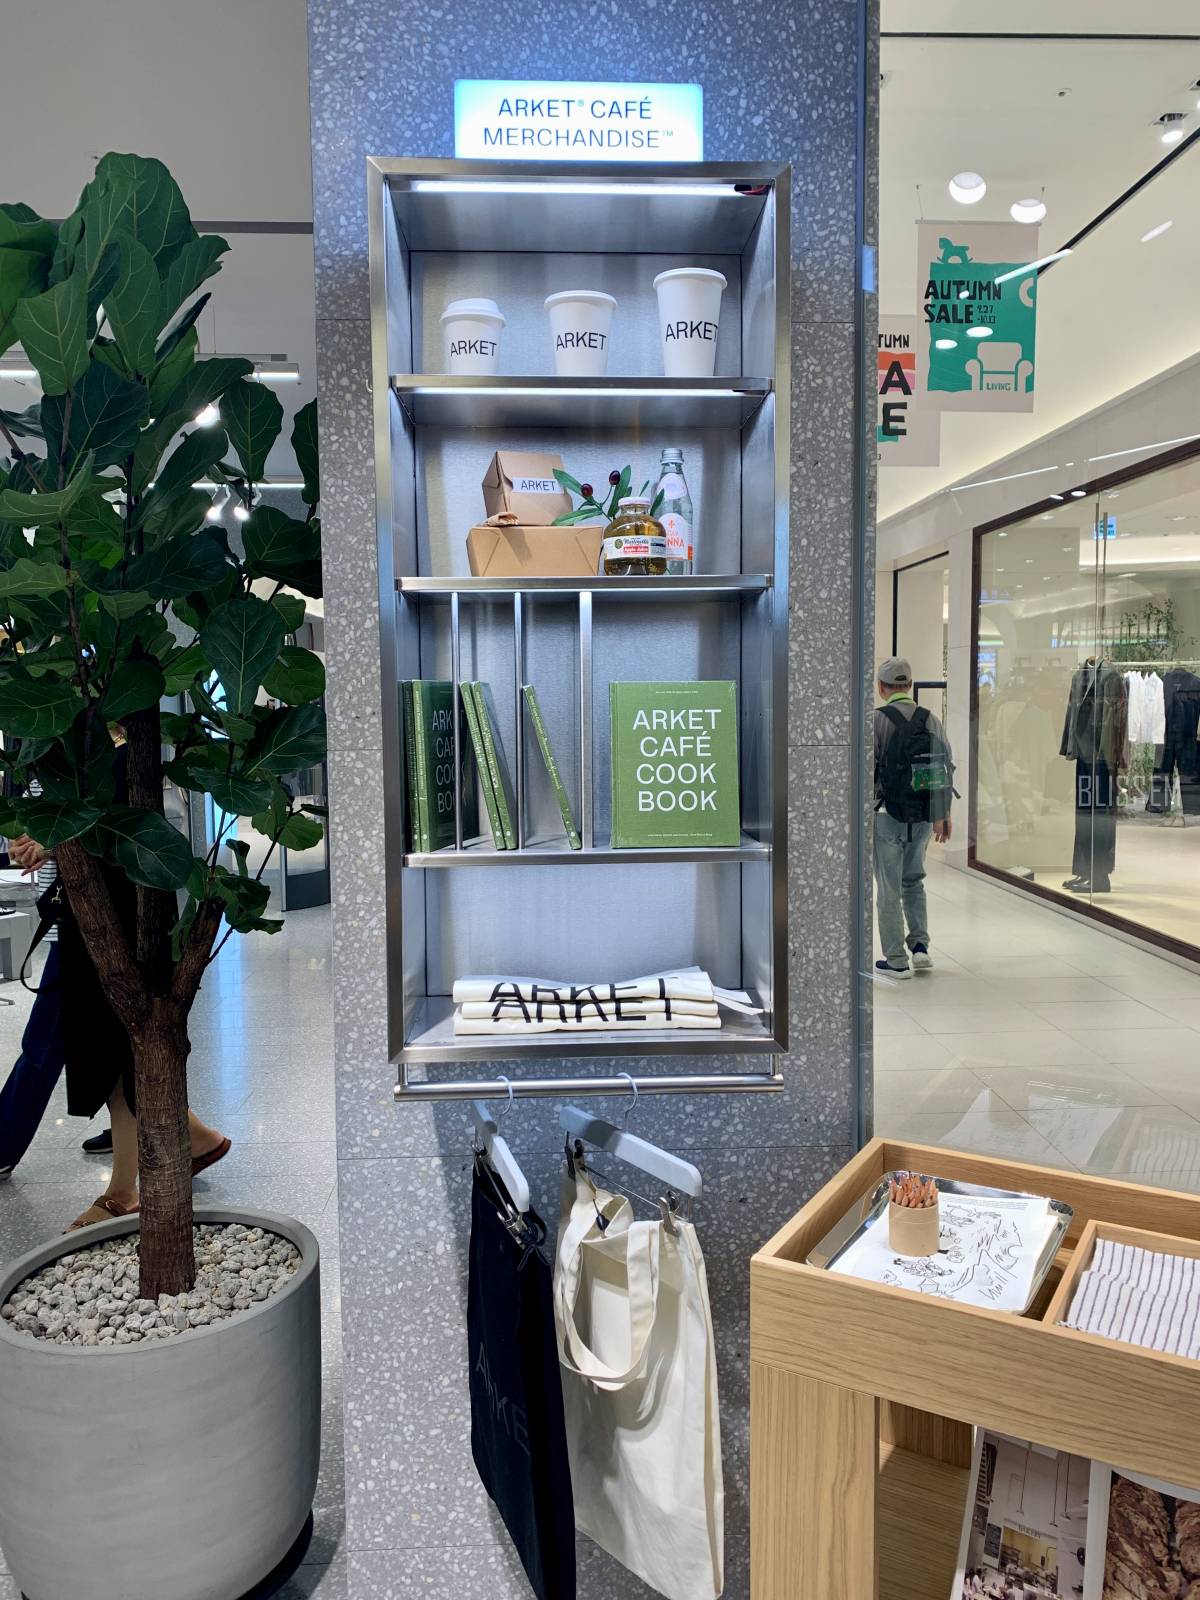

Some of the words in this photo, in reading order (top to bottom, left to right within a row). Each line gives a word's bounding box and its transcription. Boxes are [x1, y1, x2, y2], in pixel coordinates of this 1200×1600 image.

[590, 96, 652, 119] CAFÉ
[924, 279, 1002, 300] AUTUMN
[924, 303, 974, 324] SALE
[556, 331, 607, 351] ARKET
[665, 320, 719, 343] ARKET
[450, 339, 497, 357] ARKET
[520, 479, 556, 491] ARKET
[432, 709, 465, 731] ARKT
[632, 709, 722, 730] ARKET
[640, 730, 711, 757] CAFÉ
[636, 763, 717, 785] COOK
[638, 790, 718, 812] BOOK
